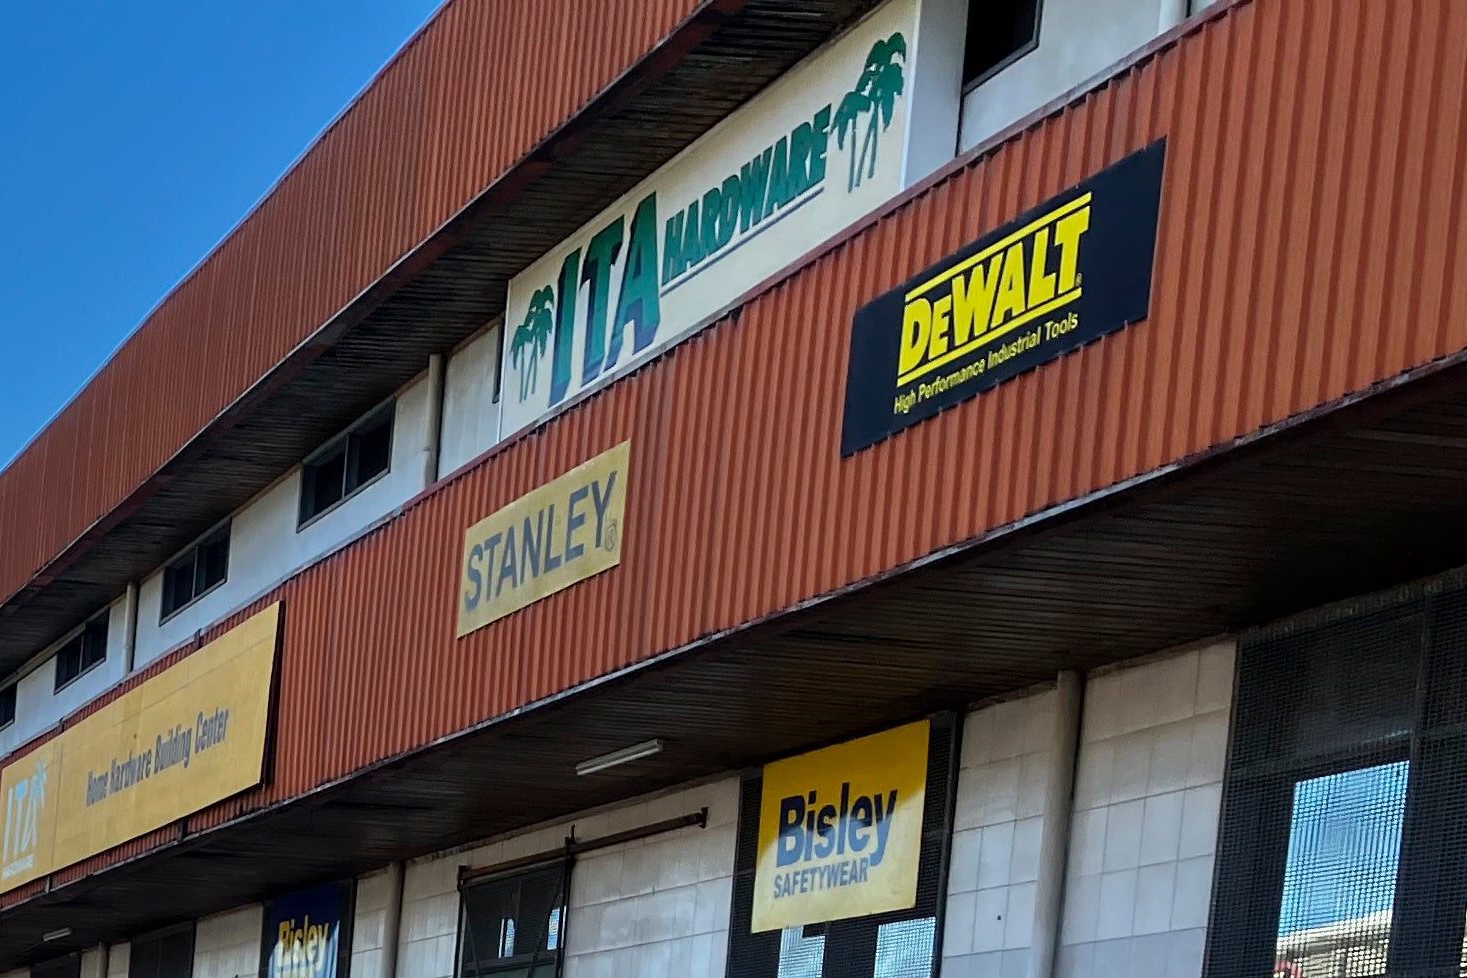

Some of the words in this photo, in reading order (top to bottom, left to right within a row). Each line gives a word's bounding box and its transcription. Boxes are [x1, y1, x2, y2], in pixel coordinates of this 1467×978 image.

[548, 190, 661, 408] ITA
[662, 103, 832, 287] HARDWARE
[894, 389, 916, 415] High
[918, 358, 986, 402] Performance
[987, 326, 1042, 370] Industrial
[1044, 312, 1079, 341] Tools
[464, 470, 618, 612] STANLEY
[154, 723, 193, 775] Building
[195, 706, 230, 754] Center
[776, 782, 898, 867] Bisley
[774, 857, 868, 899] SAFETYWEAR
[277, 914, 330, 972] Bisley
